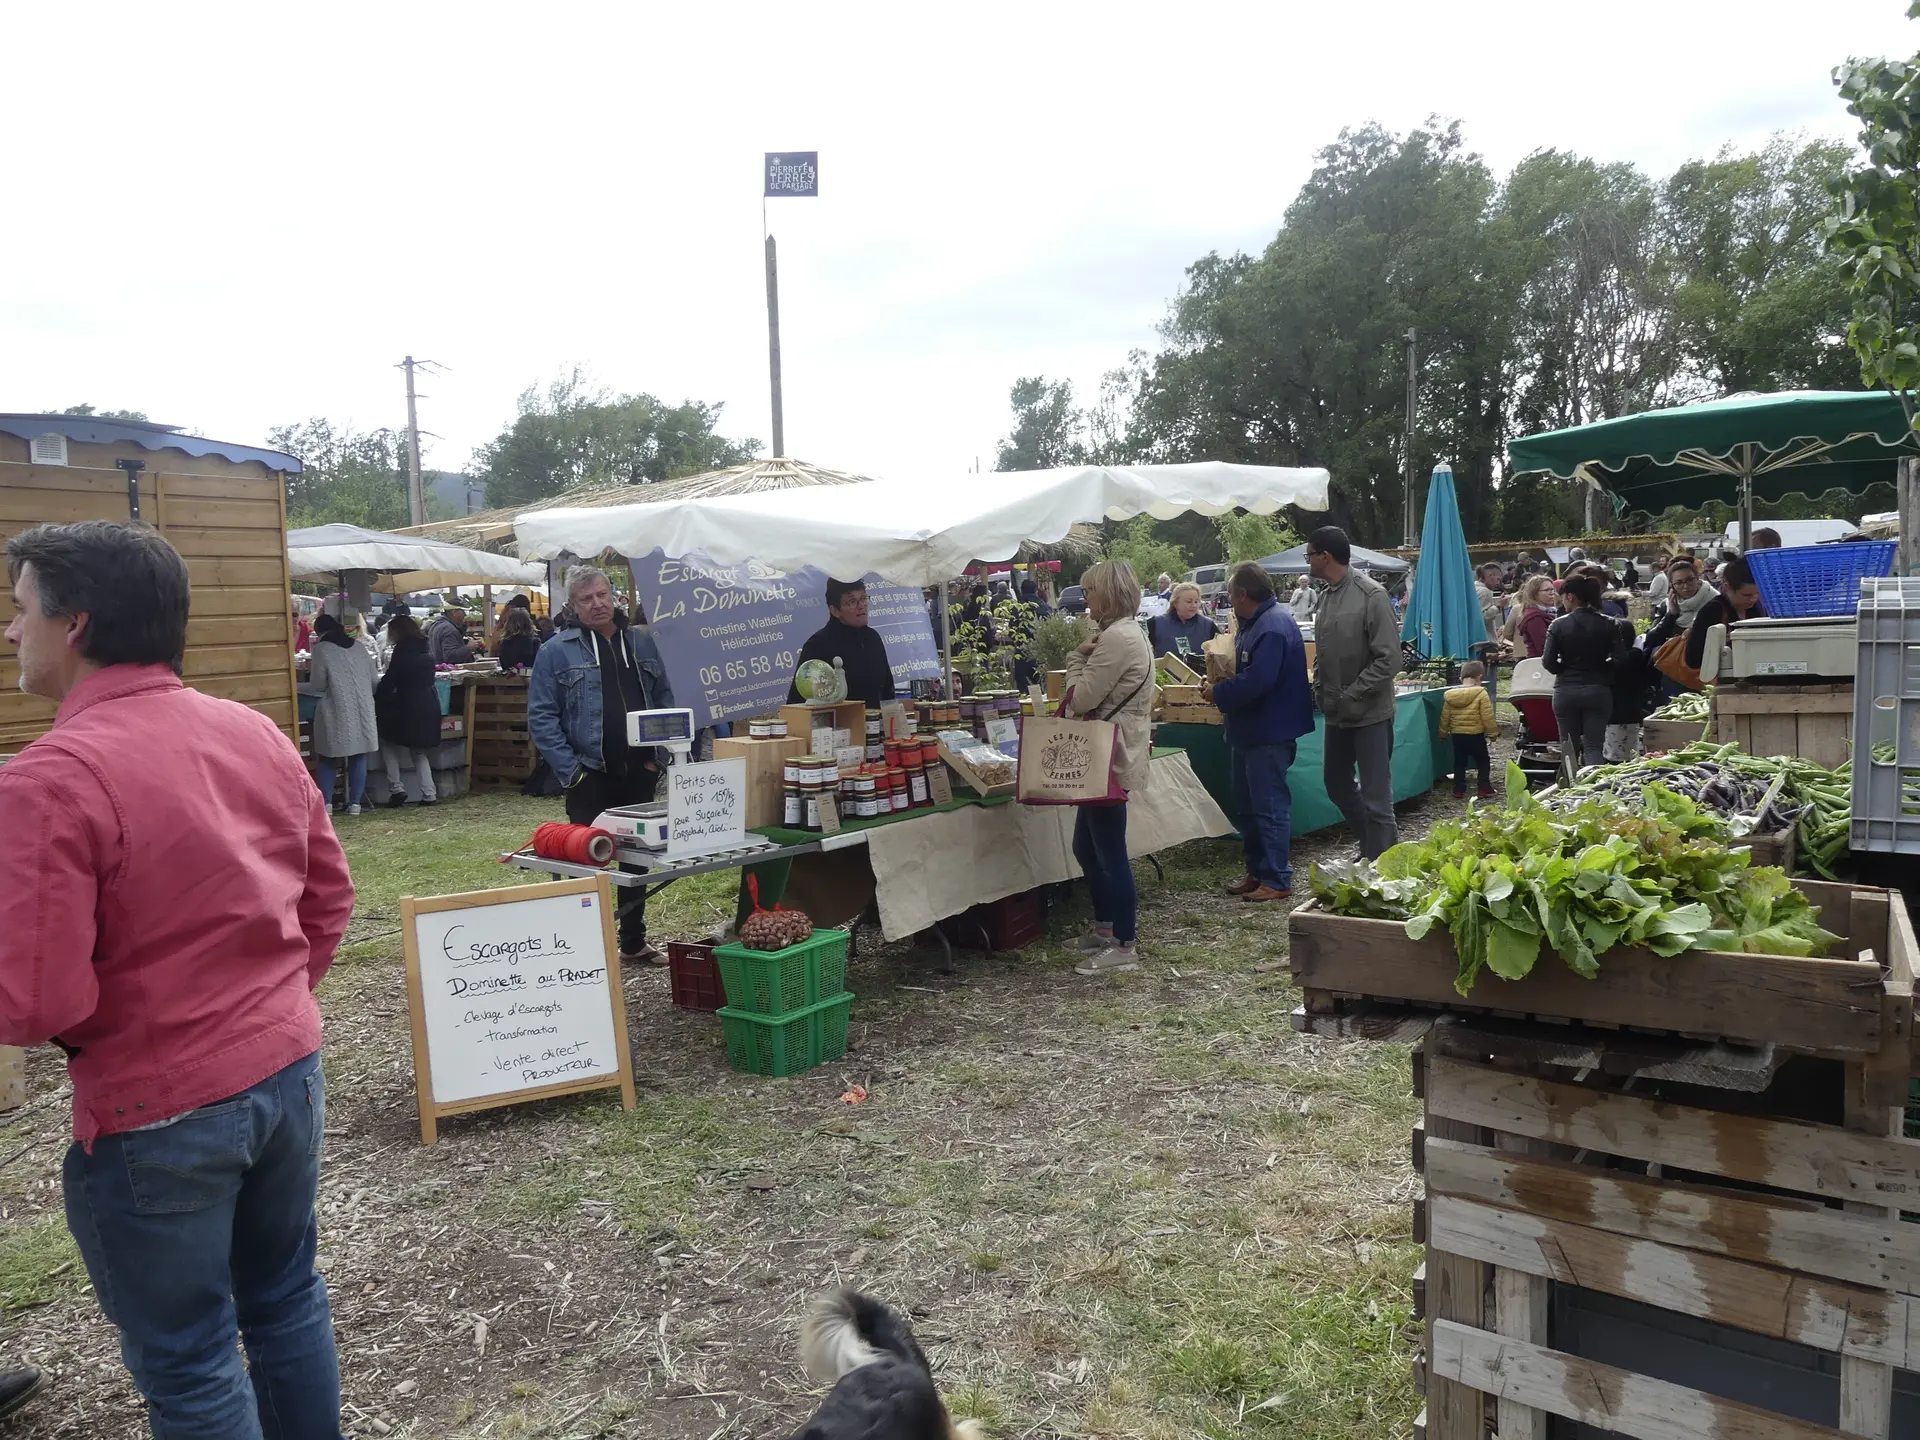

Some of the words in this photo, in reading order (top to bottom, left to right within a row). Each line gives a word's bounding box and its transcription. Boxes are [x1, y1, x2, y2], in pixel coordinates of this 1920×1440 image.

[770, 172, 815, 183] TERRES
[782, 183, 814, 191] PARTAGE
[658, 561, 740, 589] Escargot
[653, 595, 686, 623] La
[693, 583, 797, 613] Dominette
[700, 622, 747, 639] Christine
[748, 613, 793, 630] Wattellier
[721, 630, 784, 651] Hélicicultrice
[699, 665, 722, 686] 06
[725, 660, 747, 680] 65
[750, 655, 771, 675] 58
[775, 650, 794, 670] 49
[722, 700, 755, 714] facebook
[756, 693, 784, 707] Escargot
[1048, 733, 1063, 744] LES
[1068, 733, 1088, 744] HUIT
[675, 774, 706, 790] Petits
[709, 774, 726, 785] Gris
[1050, 770, 1082, 779] FERMES
[443, 925, 542, 965] Escargots
[554, 933, 572, 950] la
[446, 973, 526, 996] Dominette
[538, 974, 556, 985] au
[557, 967, 606, 984] PRADET
[507, 1000, 563, 1018] d'Escargots
[484, 1025, 558, 1042] transformation
[493, 1054, 536, 1071] Vente
[541, 1041, 589, 1060] direct
[522, 1058, 600, 1084] PRODUCTEUR
